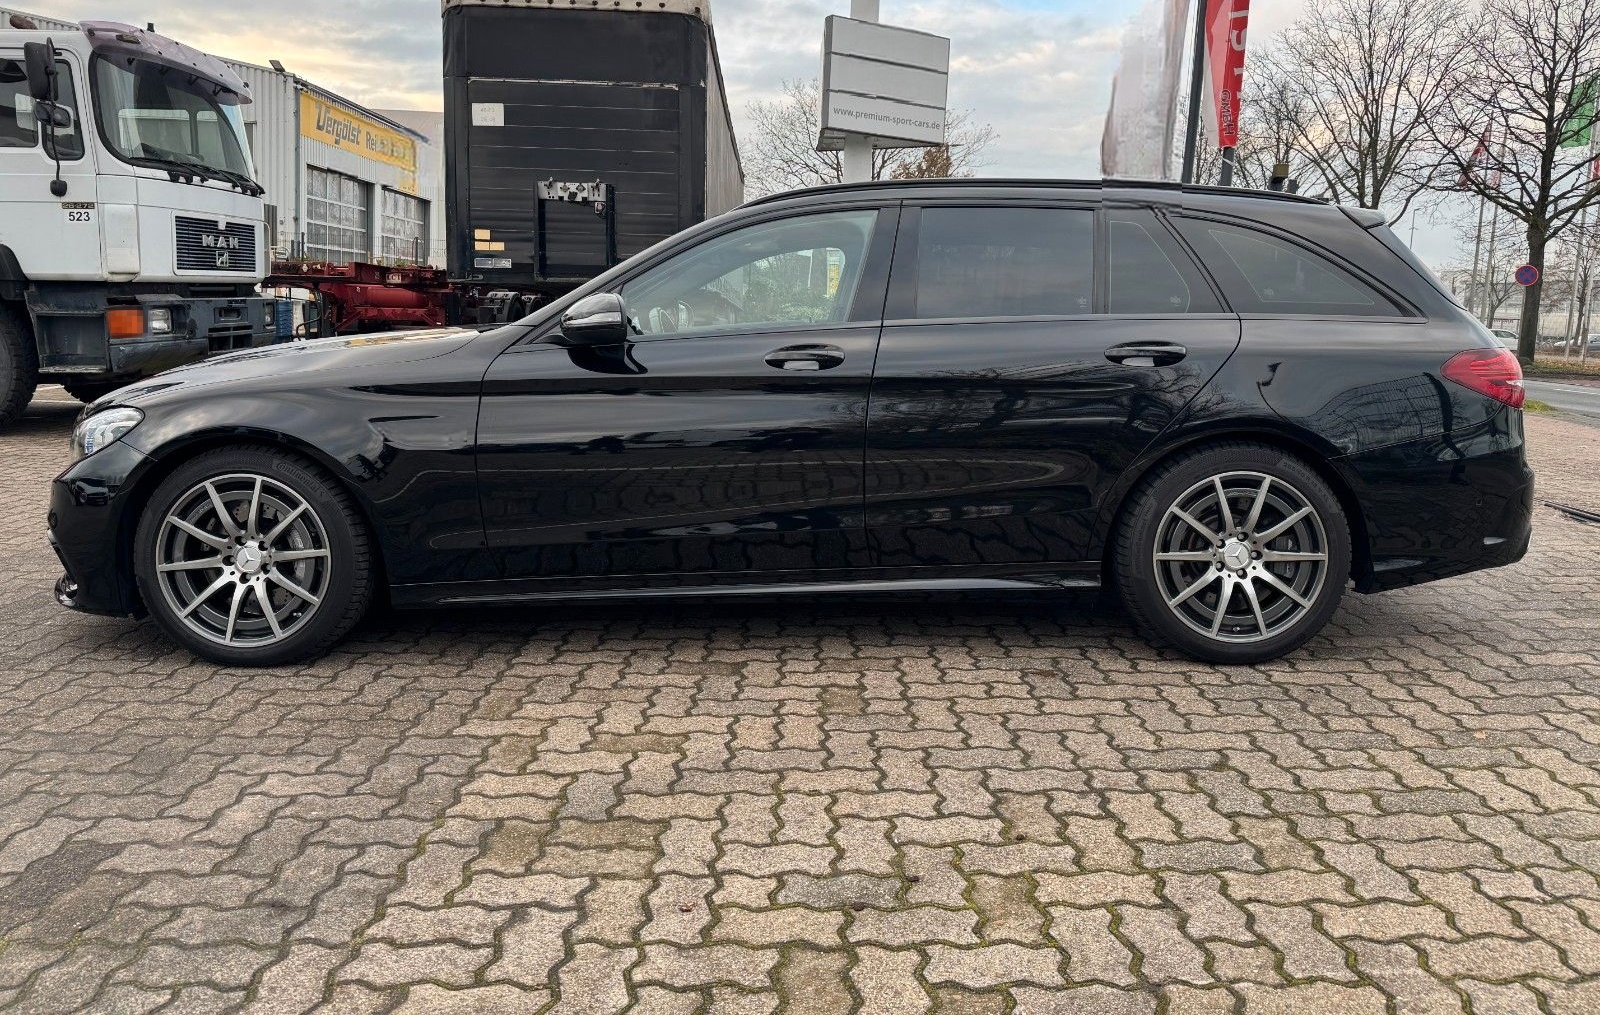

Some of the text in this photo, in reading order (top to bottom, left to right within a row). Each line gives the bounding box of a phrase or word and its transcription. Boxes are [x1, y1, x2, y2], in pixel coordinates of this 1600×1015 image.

[316, 102, 361, 145] Vergölst
[833, 106, 940, 130] www.premium-sport-cars.de
[68, 211, 90, 222] 523
[202, 234, 239, 249] MAN
